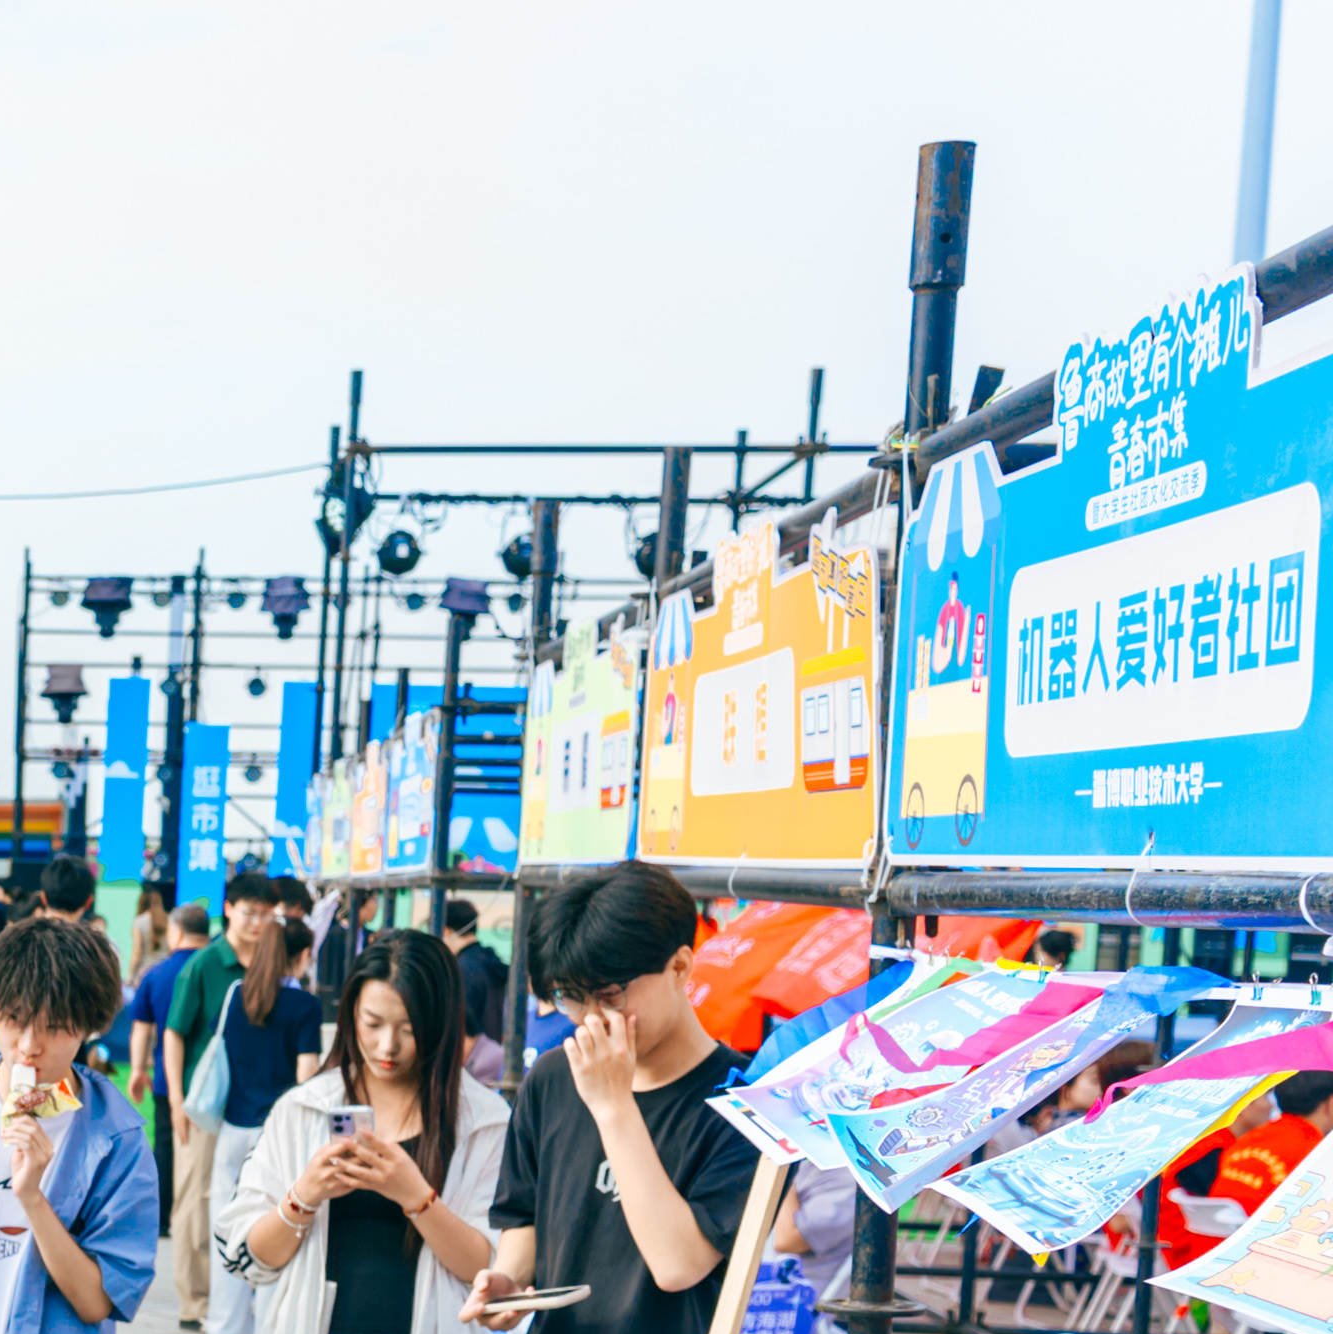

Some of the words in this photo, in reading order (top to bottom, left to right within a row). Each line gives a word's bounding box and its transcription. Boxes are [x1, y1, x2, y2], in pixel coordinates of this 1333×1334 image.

[1059, 278, 1250, 451] 鲁商故里有个摊儿
[1107, 396, 1190, 489] 青春市集
[1092, 476, 1200, 525] 暨大学生社团文化交流季
[1016, 550, 1306, 708] 机器人爱好者社团
[1091, 762, 1205, 809] 淄博职业技术大学
